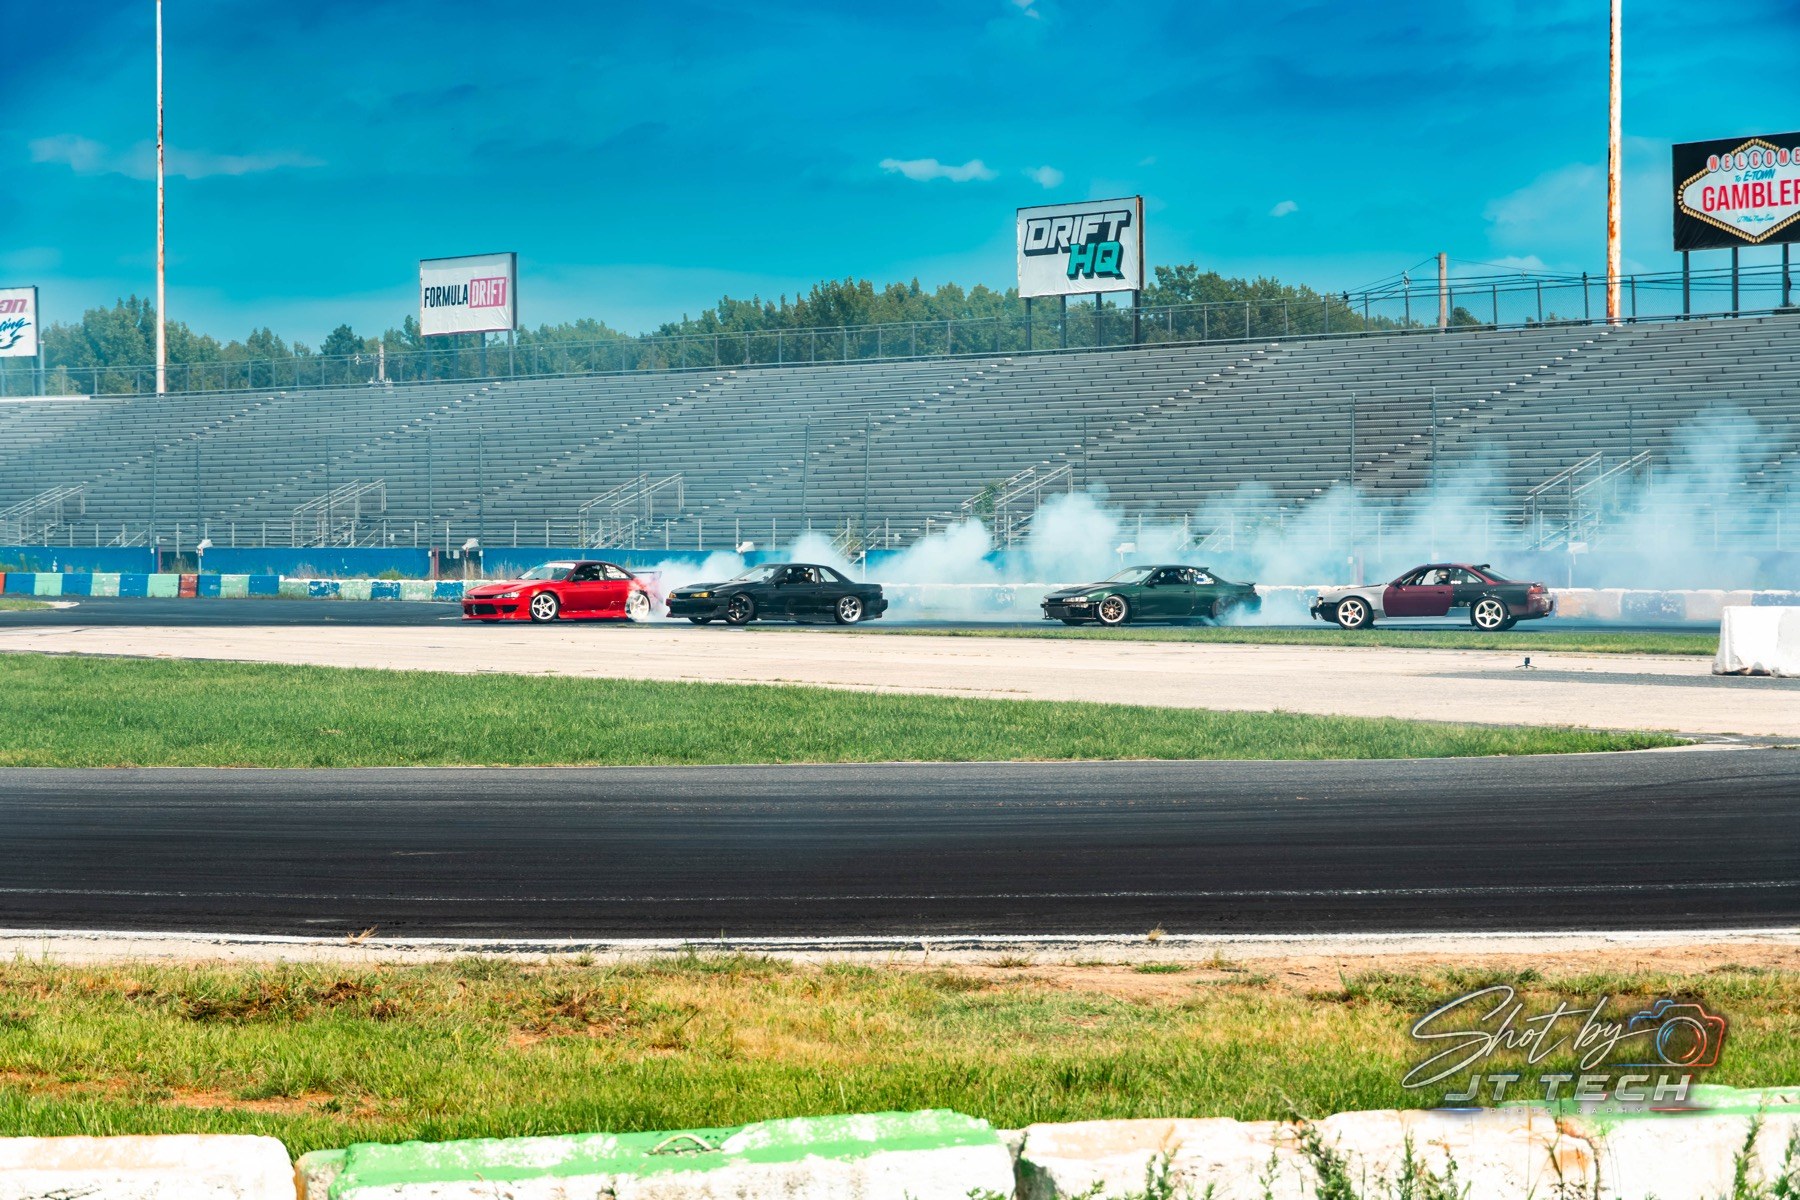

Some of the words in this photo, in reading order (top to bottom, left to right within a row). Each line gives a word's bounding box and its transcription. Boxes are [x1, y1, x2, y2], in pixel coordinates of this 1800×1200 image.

[1708, 148, 1800, 170] WELCOME
[1743, 168, 1776, 181] E-TOWN
[1024, 210, 1132, 257] DRIFT
[1067, 241, 1126, 281] HQ
[424, 284, 469, 309] FORMULA
[471, 278, 505, 307] DRIFT
